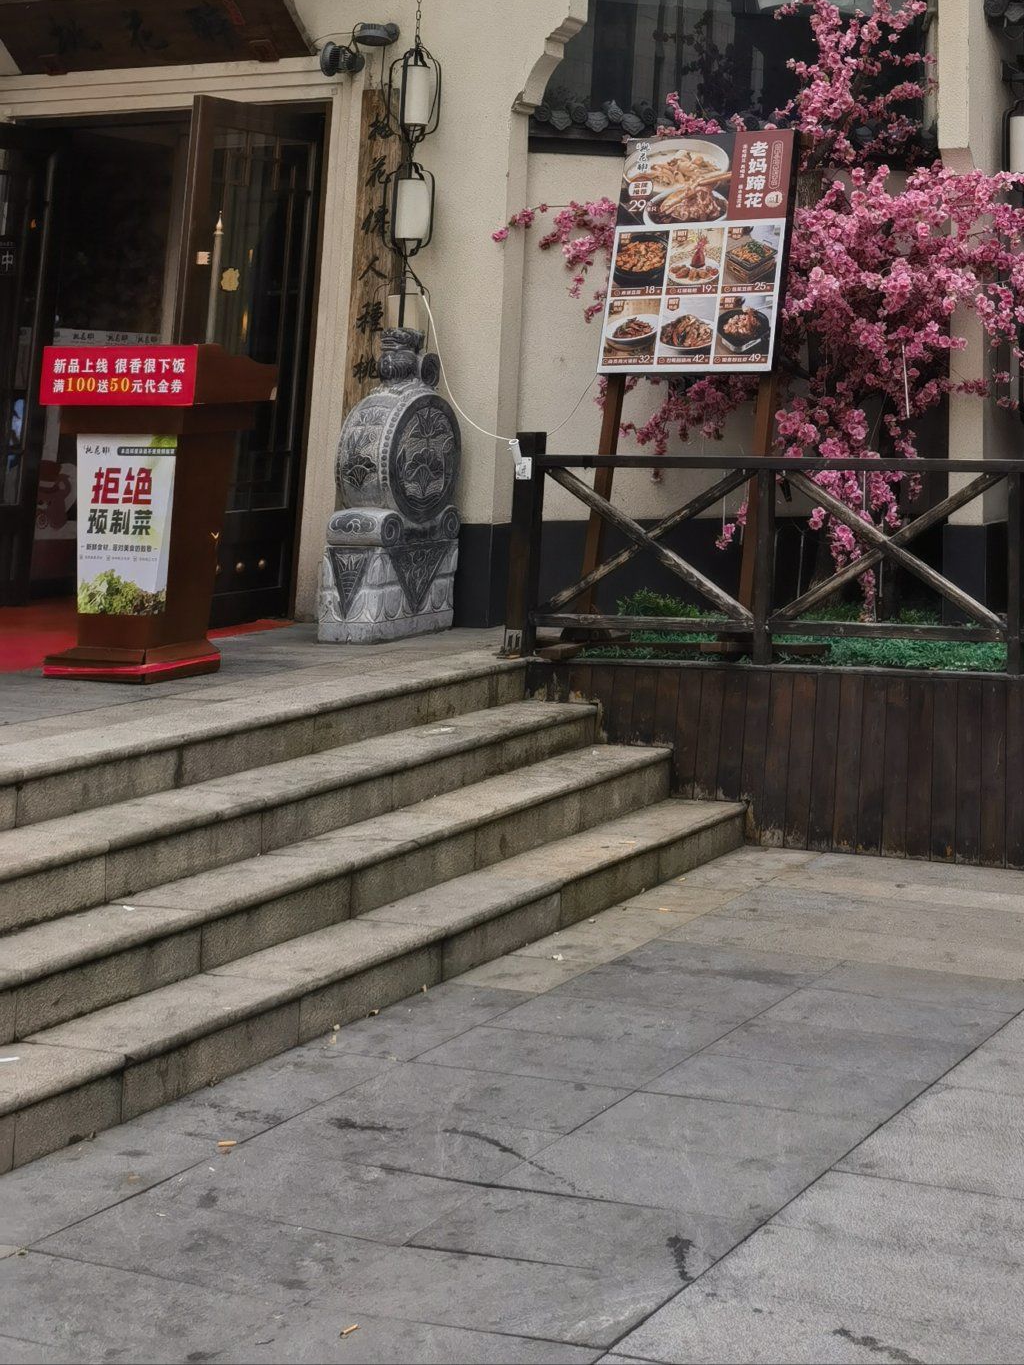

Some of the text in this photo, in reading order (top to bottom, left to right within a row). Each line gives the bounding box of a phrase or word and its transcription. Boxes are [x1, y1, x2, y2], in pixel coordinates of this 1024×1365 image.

[744, 140, 769, 208] 老妈蹄花
[628, 199, 646, 212] 29
[53, 357, 186, 374] 新品上线 很香很下饭
[52, 376, 183, 394] 满100送50元代金券
[91, 466, 152, 505] 拒绝
[86, 508, 153, 536] 预制菜
